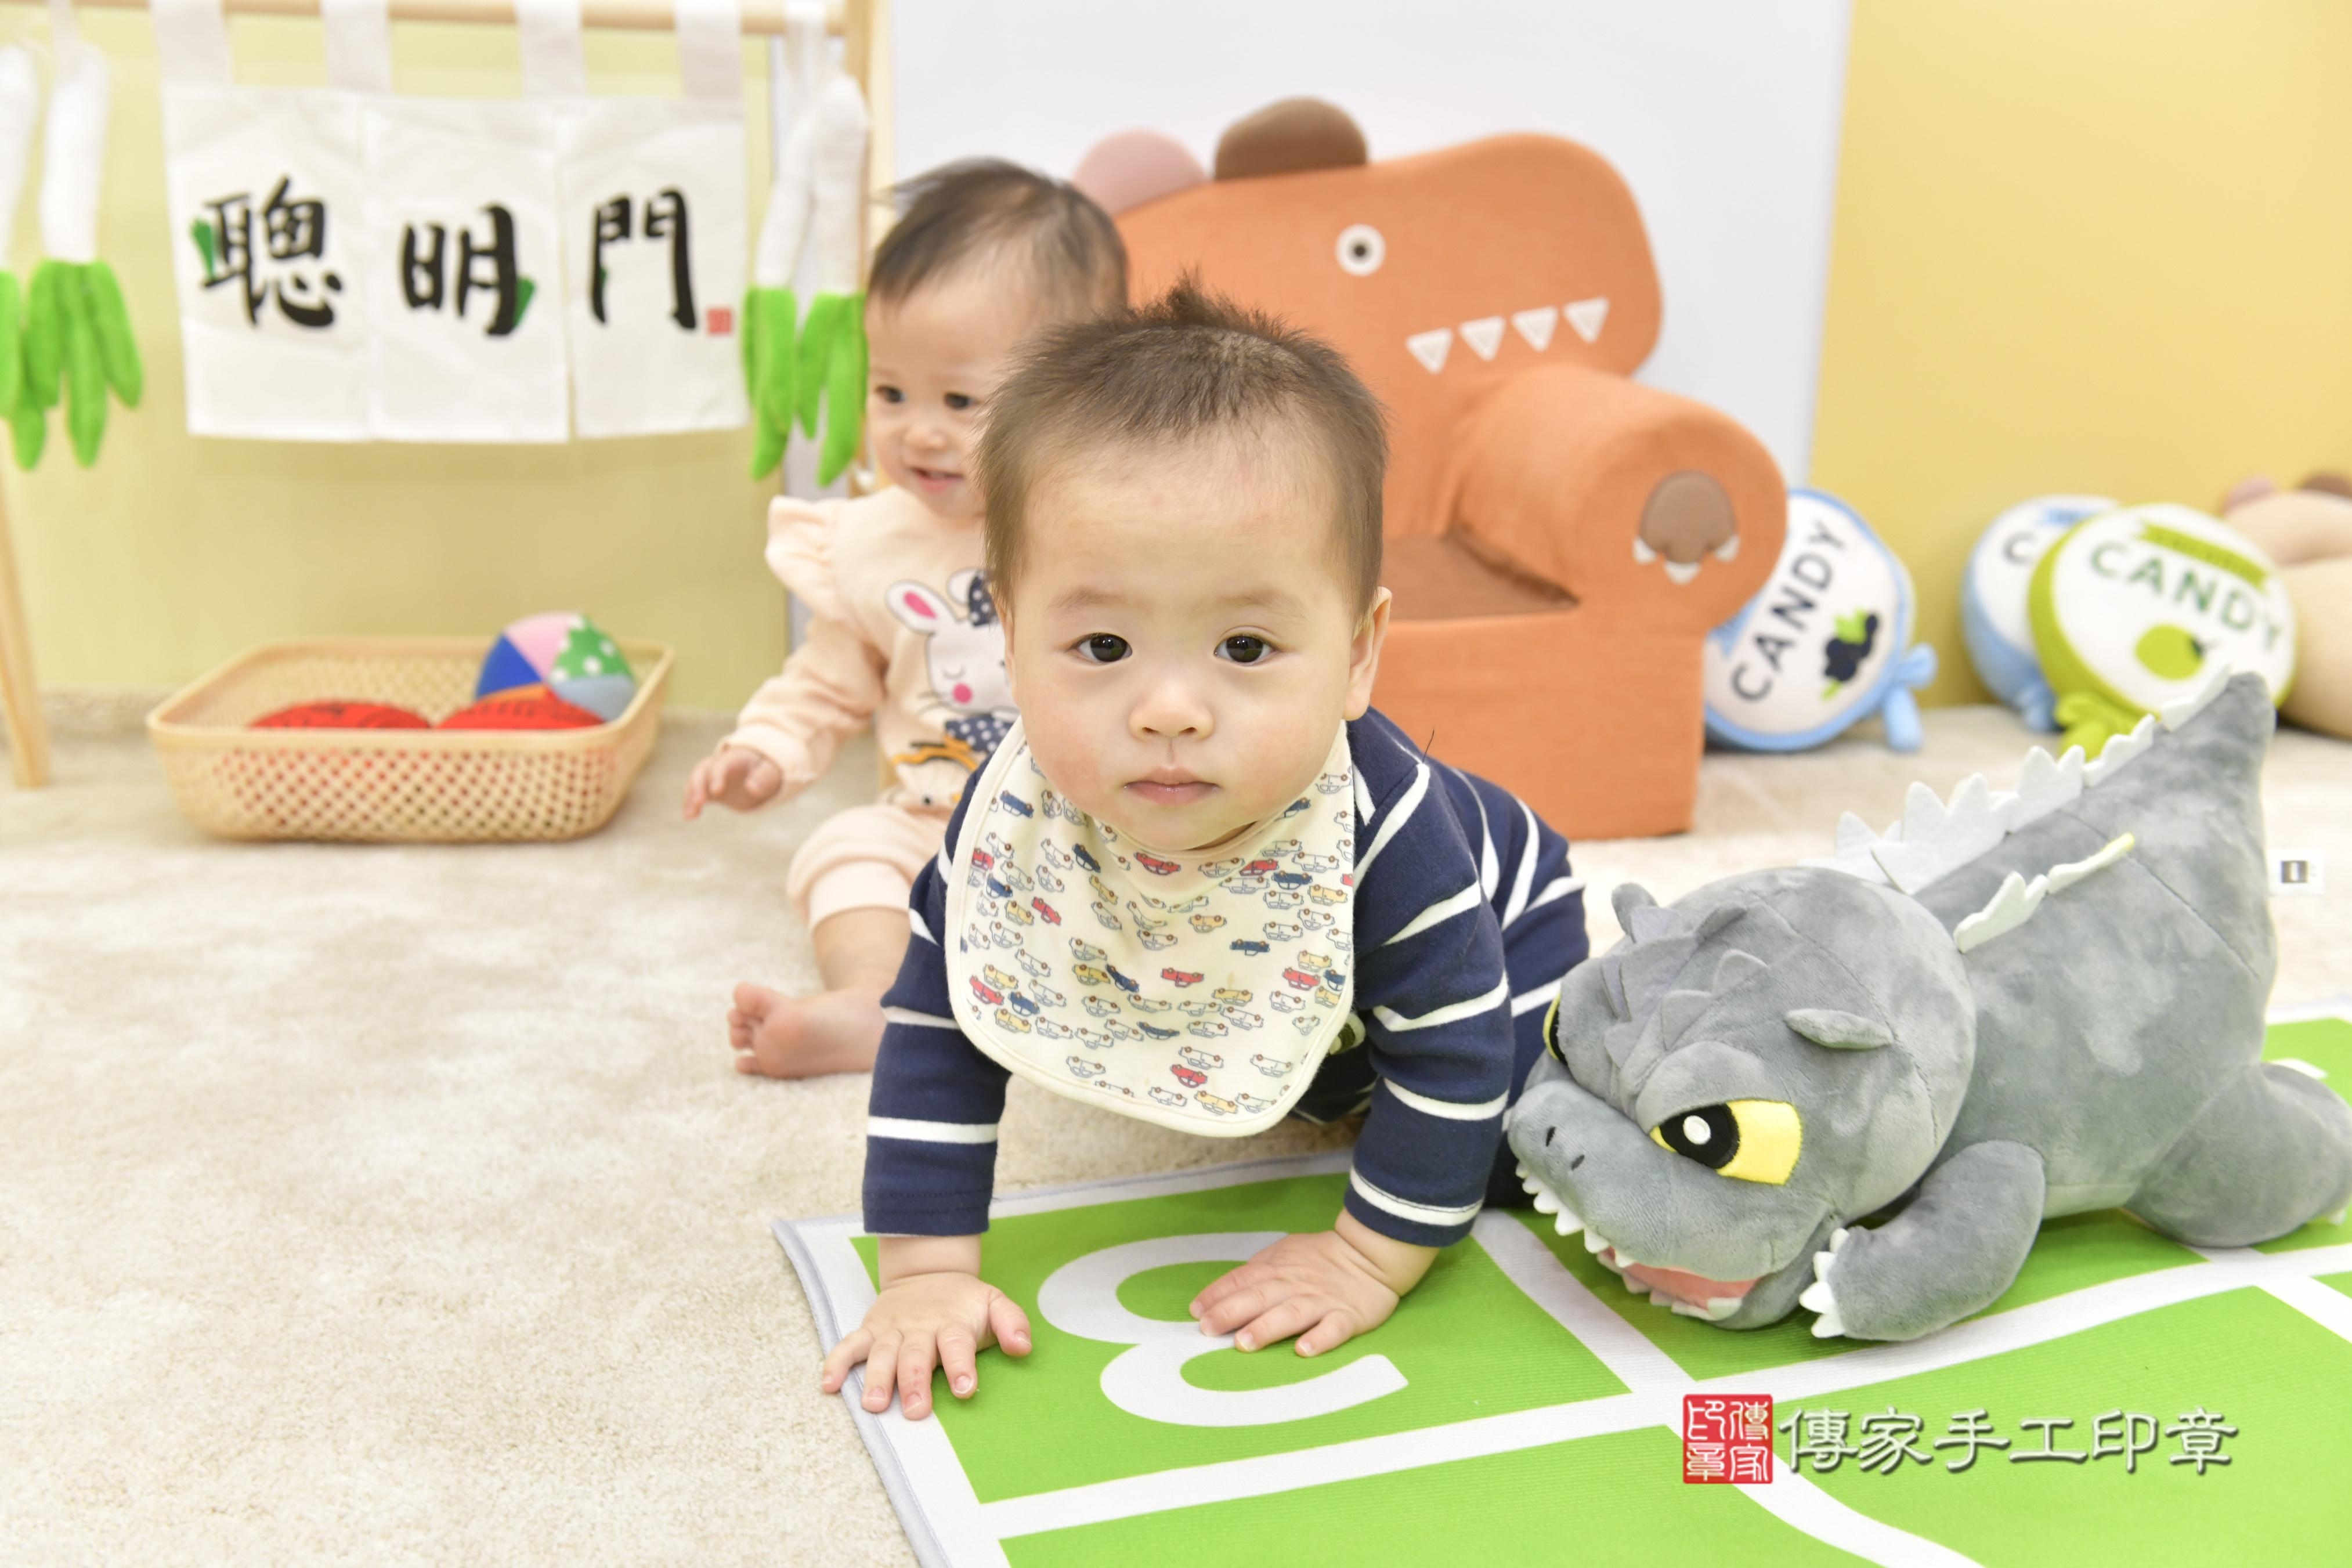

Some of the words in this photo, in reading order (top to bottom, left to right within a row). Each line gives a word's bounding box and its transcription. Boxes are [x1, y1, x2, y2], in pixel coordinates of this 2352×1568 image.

[200, 176, 698, 337] 聰明門
[1730, 519, 1846, 700] CANDY
[2090, 541, 2281, 651] CANDY
